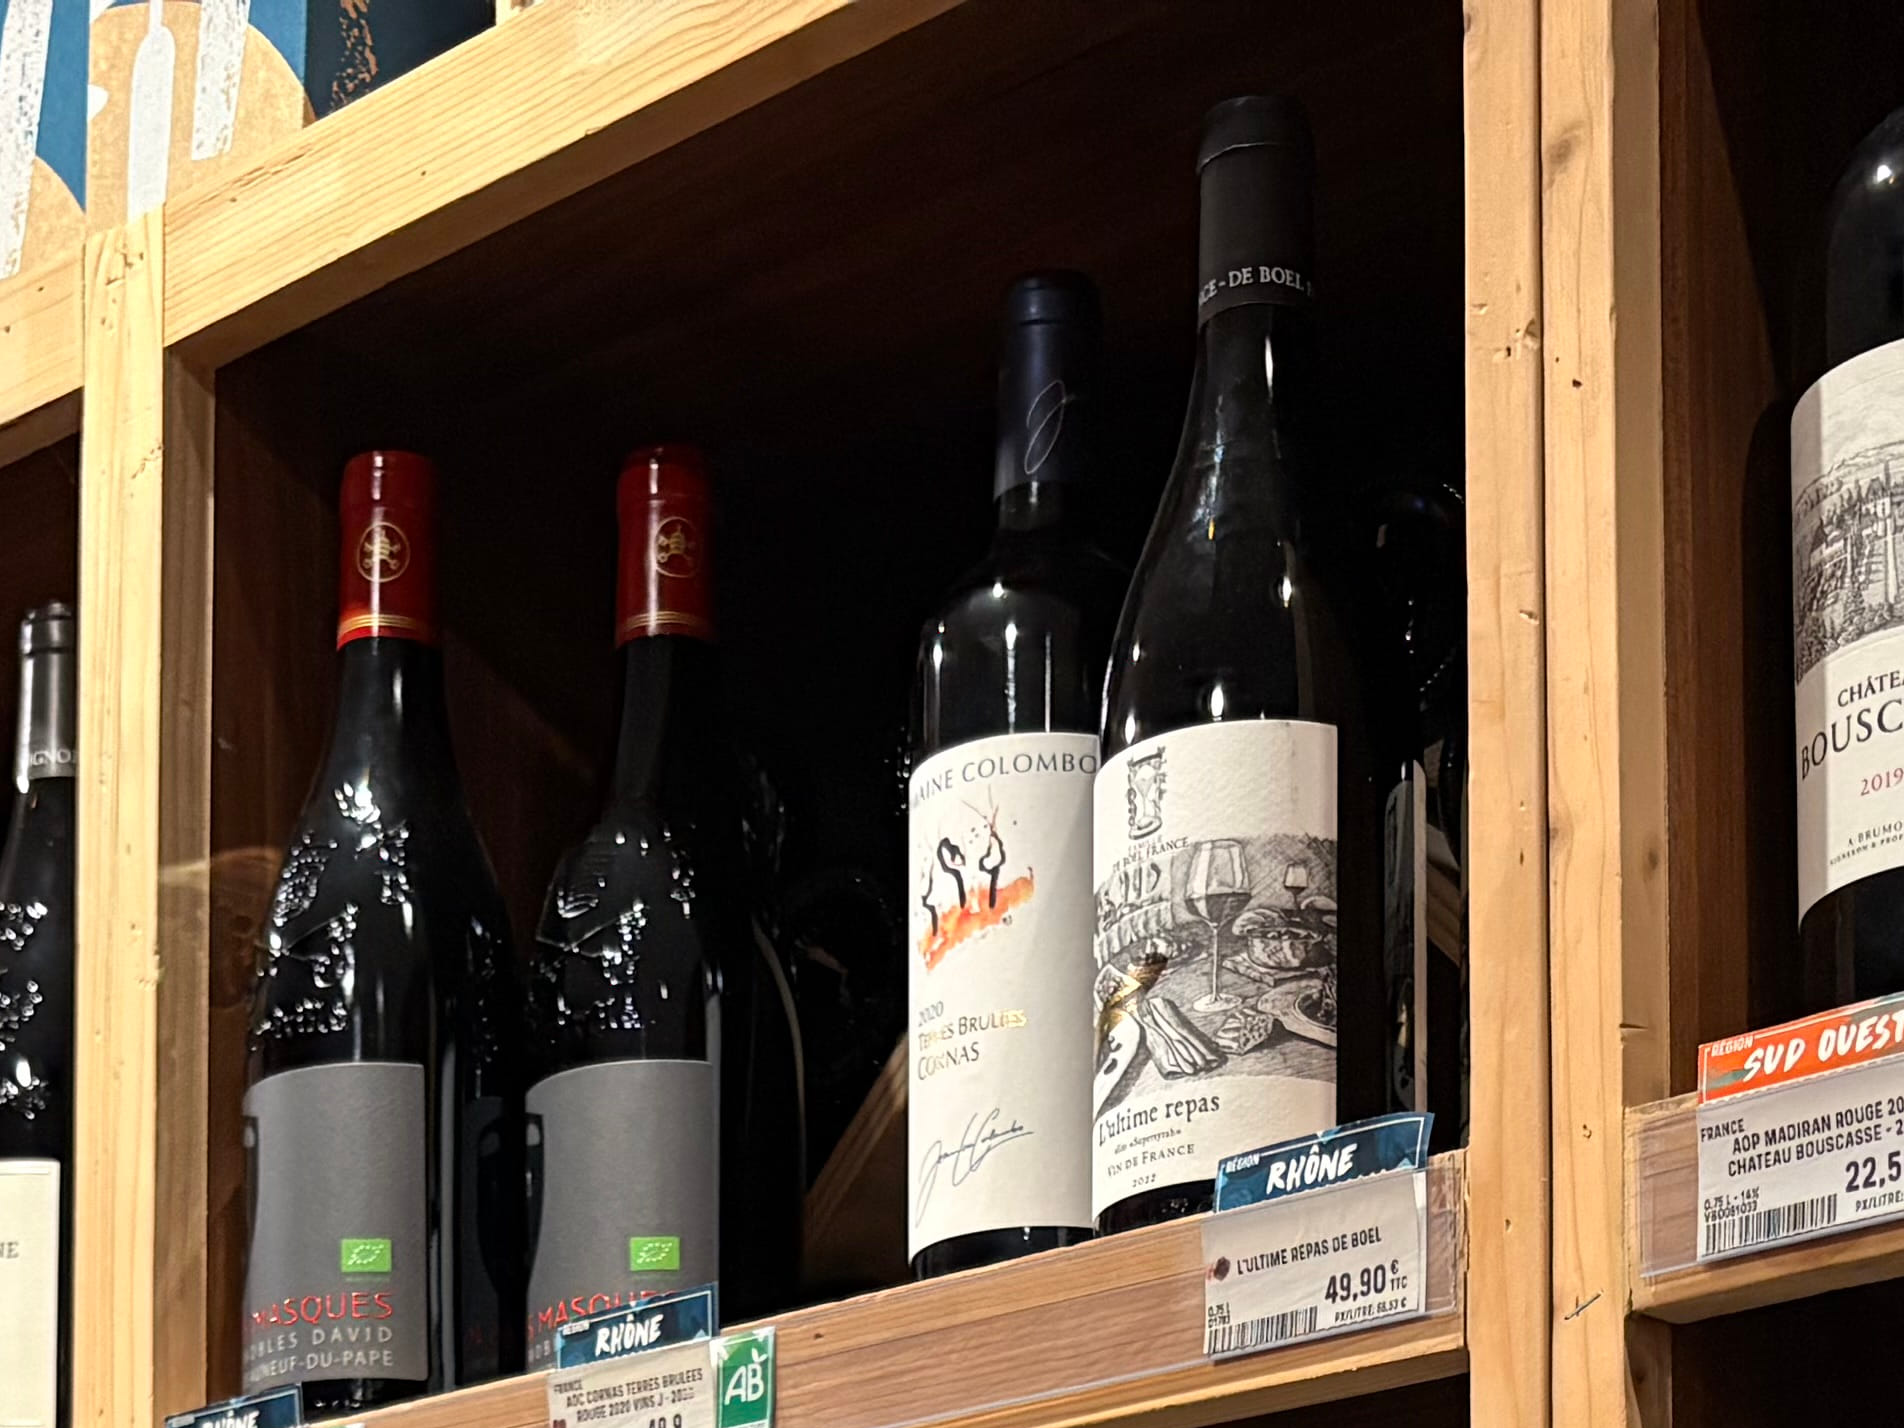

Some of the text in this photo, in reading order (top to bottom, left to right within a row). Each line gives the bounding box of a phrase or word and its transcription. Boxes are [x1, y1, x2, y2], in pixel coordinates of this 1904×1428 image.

[1229, 264, 1304, 290] DE BOEL
[962, 753, 1096, 782] COLOMBO
[1860, 768, 1904, 796] 2019
[1743, 1038, 1806, 1082] SUD
[1099, 1106, 1158, 1147] L'ultime
[1165, 1093, 1221, 1129] repas
[1700, 1118, 1744, 1142] FRANCE
[1732, 1133, 1760, 1155] AOP
[1765, 1113, 1832, 1147] MADIRAN
[1836, 1101, 1883, 1129] ROUGE
[1125, 1143, 1195, 1170] DE FRANCE
[1266, 1143, 1358, 1194] RHÔNE
[1728, 1149, 1791, 1177] CHATEAU
[1796, 1124, 1882, 1160] BOUSCASSE
[1237, 1226, 1382, 1276] L'ULTIME REPAS DE BOEL
[1325, 1264, 1386, 1304] 49,90
[1391, 1276, 1407, 1292] TTC
[312, 1326, 393, 1346] DAVID
[595, 1314, 664, 1357] RHÔNE
[626, 1377, 660, 1396] TERRES
[724, 1364, 764, 1406] AB
